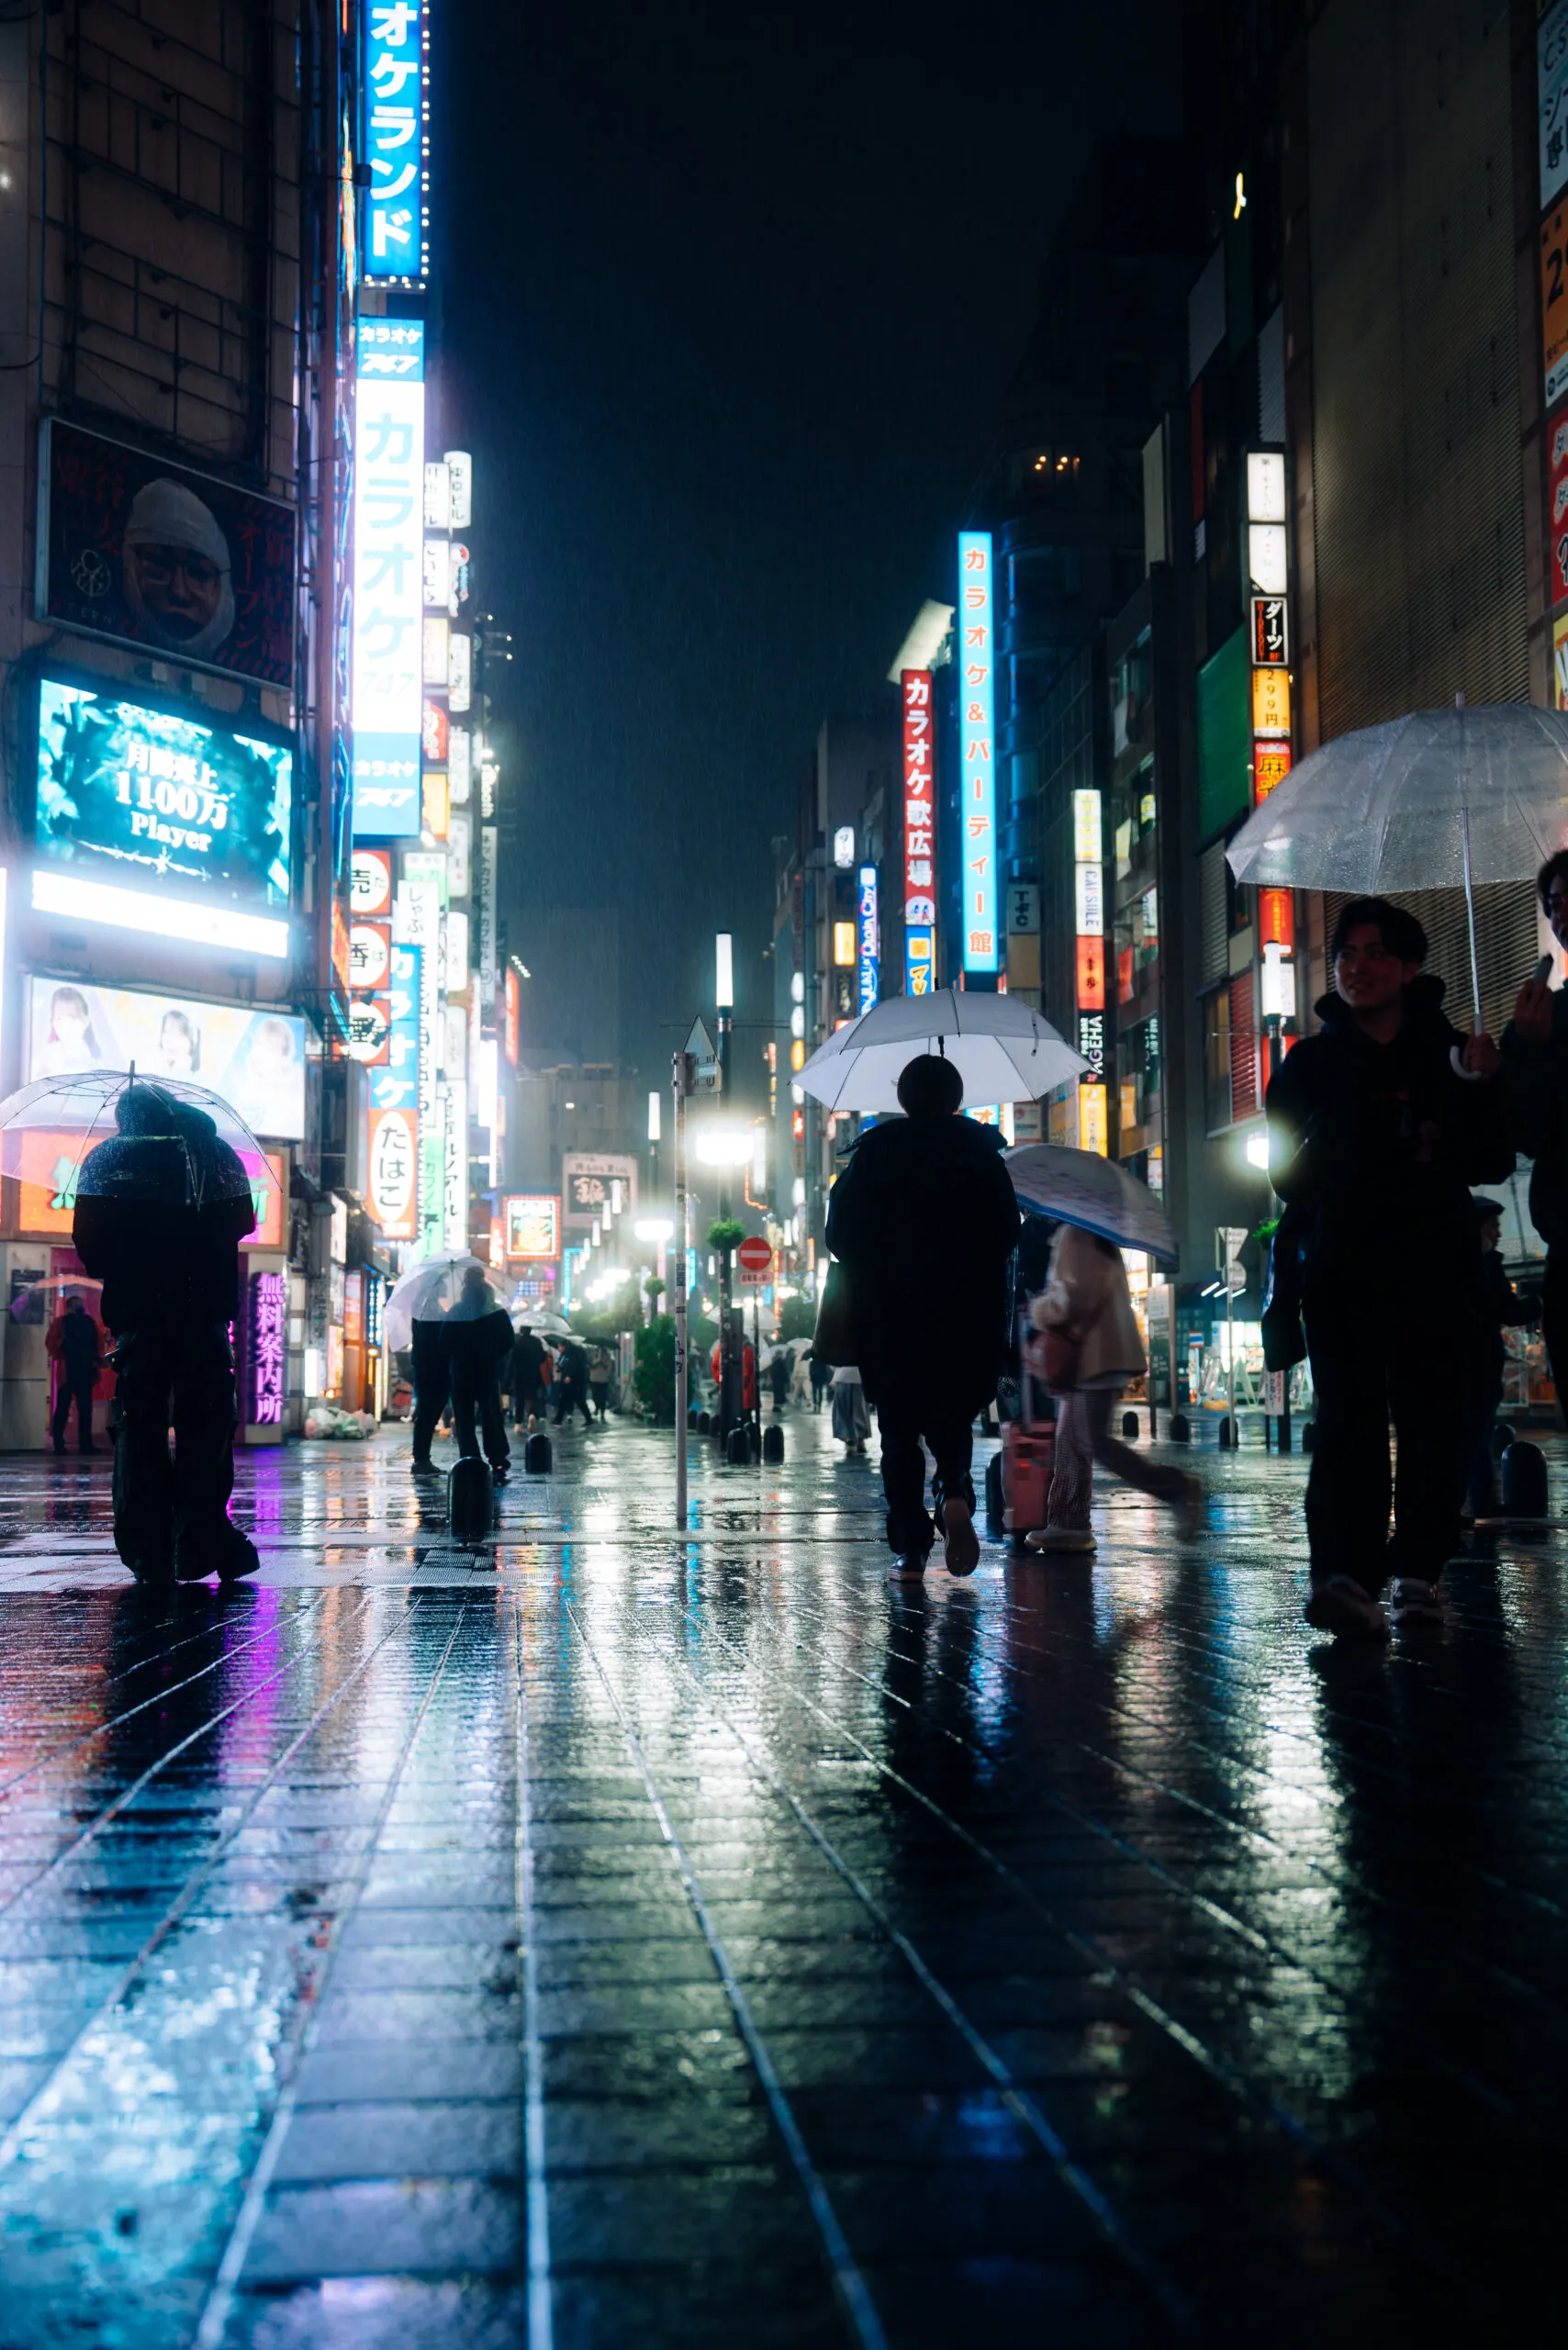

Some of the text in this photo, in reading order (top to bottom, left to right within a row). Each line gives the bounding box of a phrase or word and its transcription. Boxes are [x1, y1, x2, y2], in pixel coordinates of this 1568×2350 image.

[369, 2, 418, 257] オケランド
[359, 326, 422, 345] カラオケ
[359, 413, 416, 660] カラオケ
[1266, 601, 1282, 651] ダーツ
[354, 759, 418, 778] カラオケ
[906, 677, 933, 888] カラオケ歌広場
[130, 811, 212, 852] Player
[256, 1271, 286, 1424] 無料案内所
